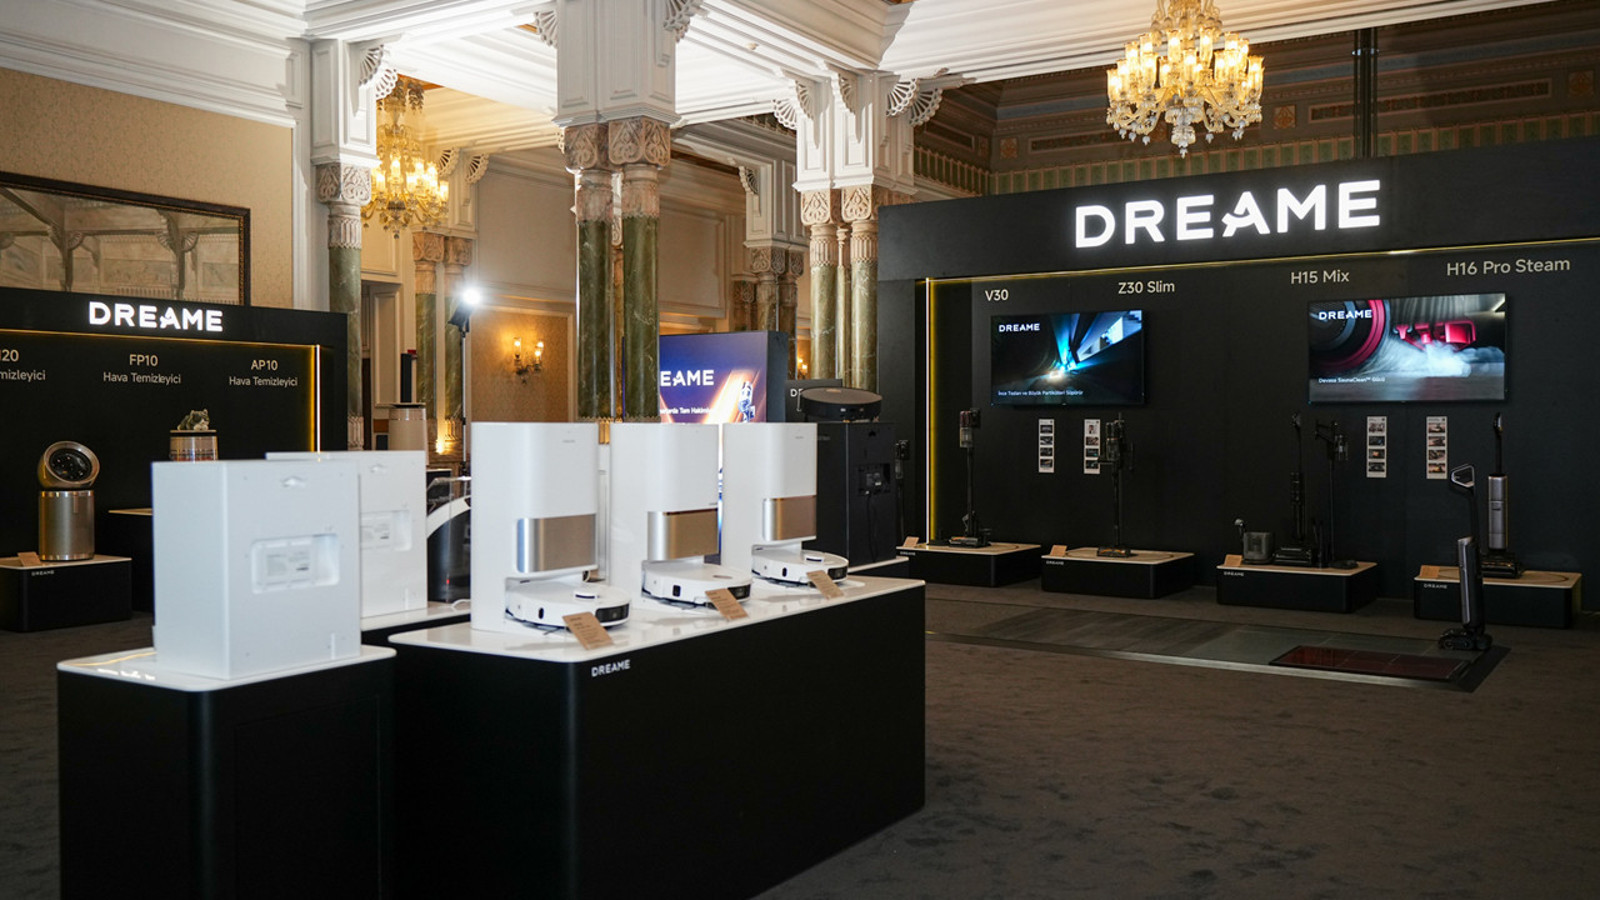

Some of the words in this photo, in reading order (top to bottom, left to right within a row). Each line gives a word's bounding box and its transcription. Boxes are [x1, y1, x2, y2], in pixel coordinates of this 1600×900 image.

[1075, 180, 1380, 248] DREAME
[1447, 262, 1478, 276] H16
[1483, 261, 1511, 275] Pro
[1515, 259, 1571, 274] Steam
[1290, 271, 1318, 285] H15
[1322, 269, 1350, 283] Mix
[1118, 281, 1142, 295] Z30
[1146, 280, 1176, 294] Slim
[985, 288, 1009, 302] V30
[89, 301, 223, 332] DREAME
[1318, 310, 1373, 321] DREAME
[998, 323, 1041, 333] DREAME
[0, 349, 20, 362] 20
[129, 354, 159, 367] FP10
[250, 359, 279, 371] AP10
[0, 369, 46, 382] mizleyici
[103, 372, 129, 383] Hava
[131, 372, 182, 386] Temizleyici
[228, 376, 251, 386] Hava
[253, 376, 298, 388] Temizleyici
[660, 369, 714, 387] EAME
[591, 659, 631, 677] DREAME
